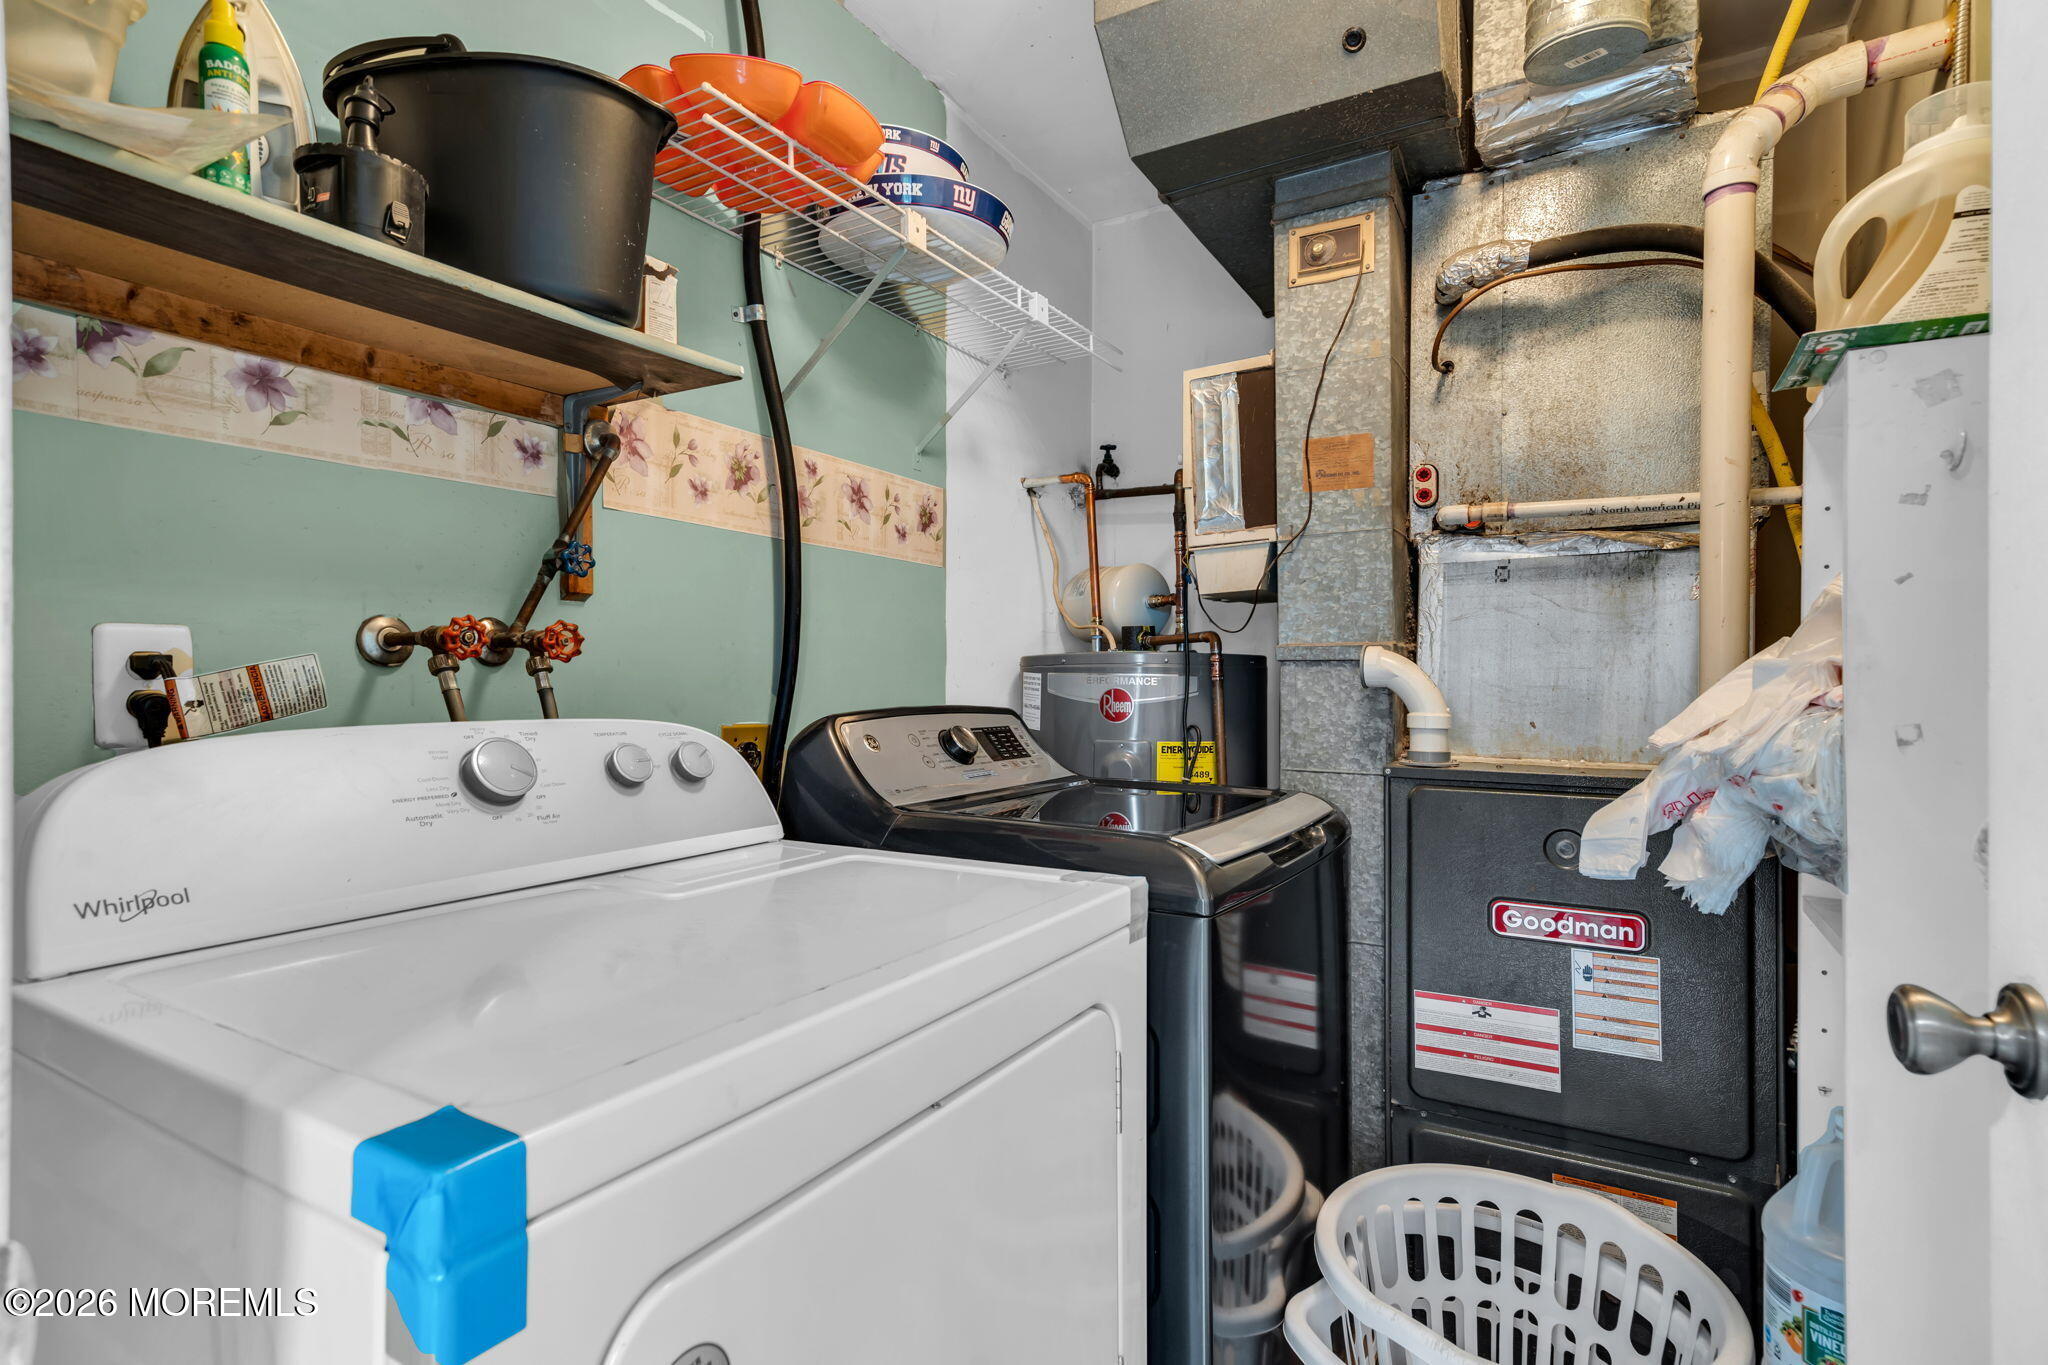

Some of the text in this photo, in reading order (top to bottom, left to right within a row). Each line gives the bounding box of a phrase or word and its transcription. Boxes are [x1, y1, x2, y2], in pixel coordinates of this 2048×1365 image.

[205, 59, 250, 82] BADGE
[882, 182, 923, 196] YORK
[1601, 505, 1630, 514] North
[1633, 503, 1684, 513] American
[249, 665, 270, 716] ADVERTENCIA
[1103, 689, 1132, 718] Rheem
[168, 688, 182, 724] WARNING
[405, 812, 443, 822] Automatic
[73, 887, 191, 922] Whirlpool
[1502, 909, 1634, 941] Goodman
